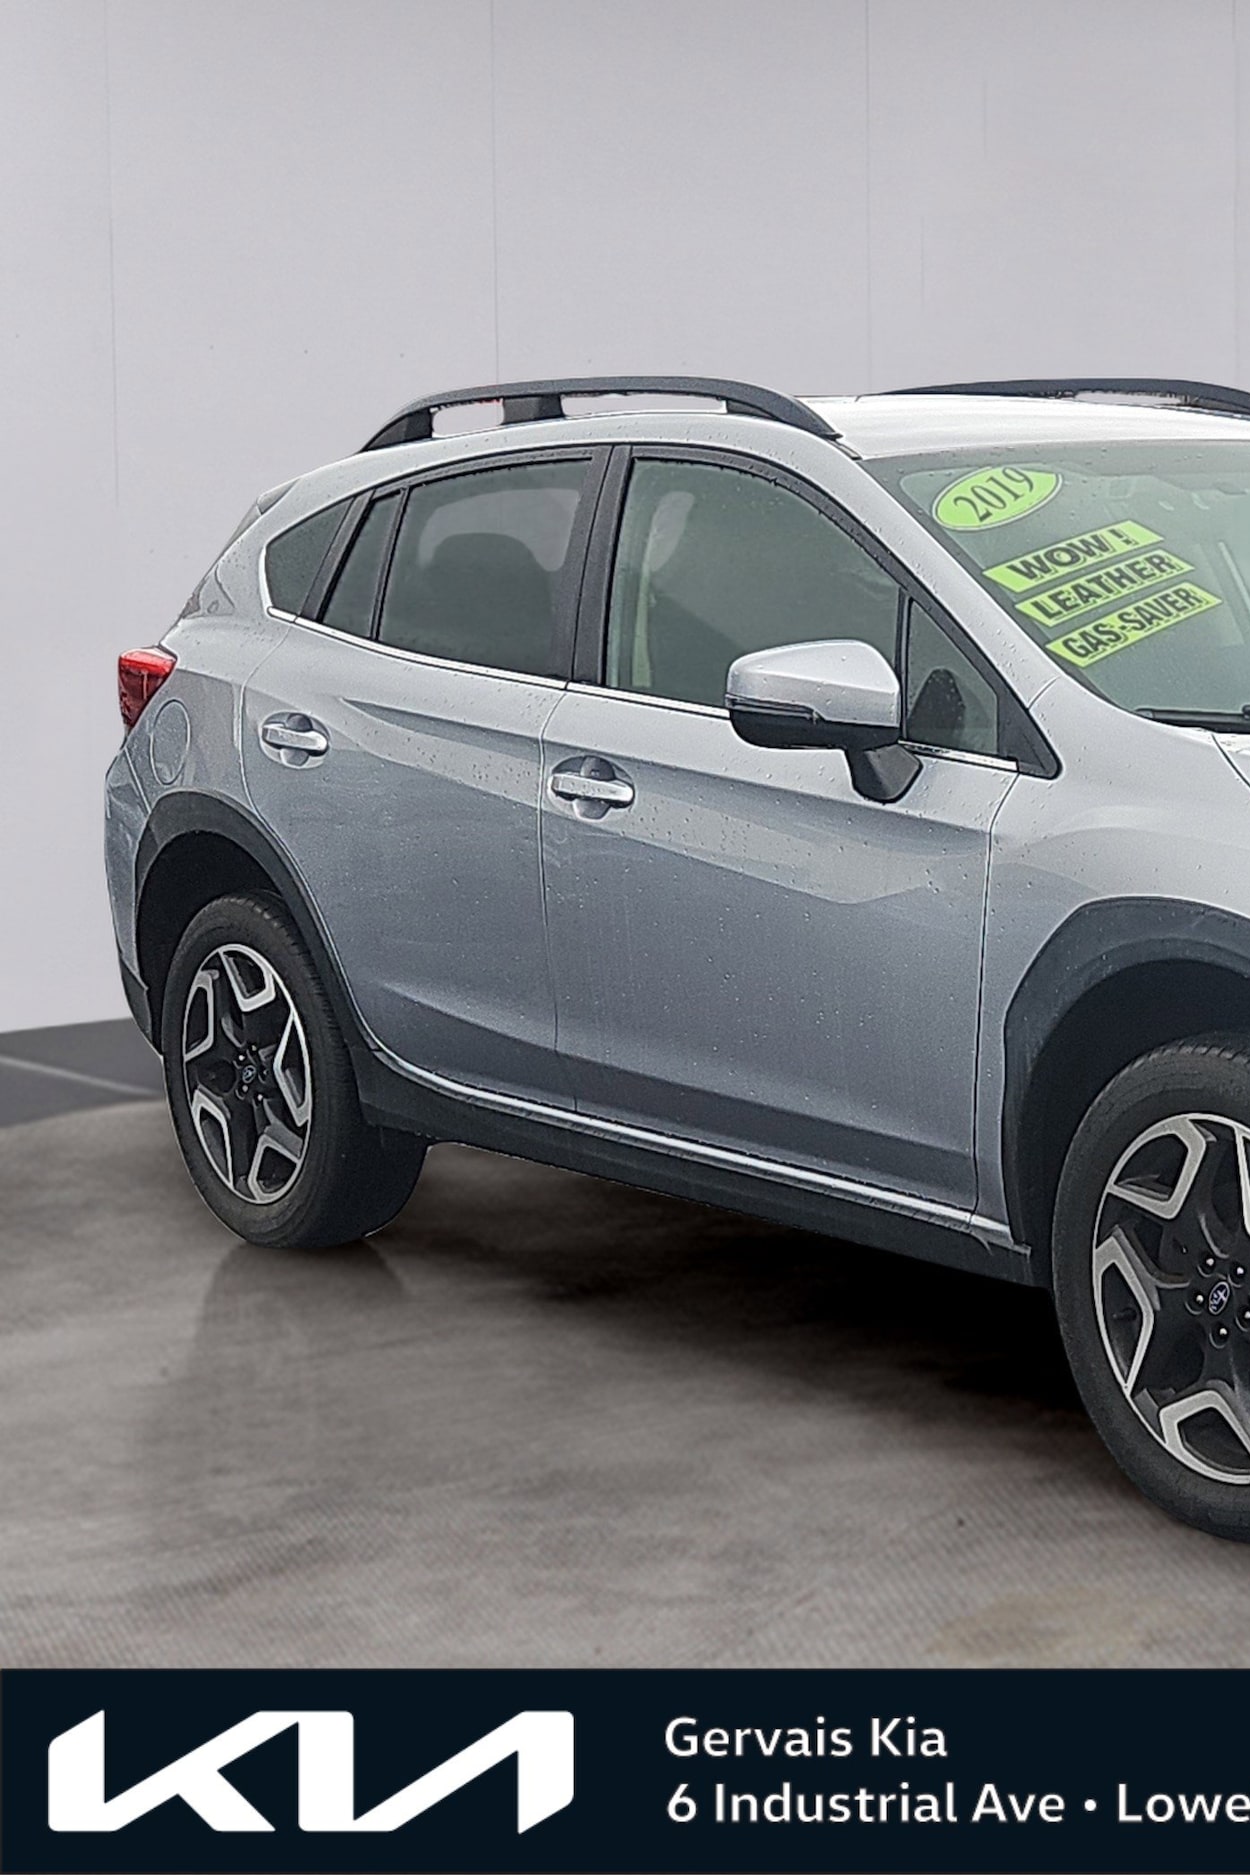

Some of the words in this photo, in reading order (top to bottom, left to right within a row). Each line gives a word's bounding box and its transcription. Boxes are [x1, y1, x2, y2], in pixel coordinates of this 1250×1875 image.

[953, 467, 1034, 522] 2019
[1031, 555, 1177, 619] LEATHER
[1062, 588, 1204, 659] GAS-SAVER
